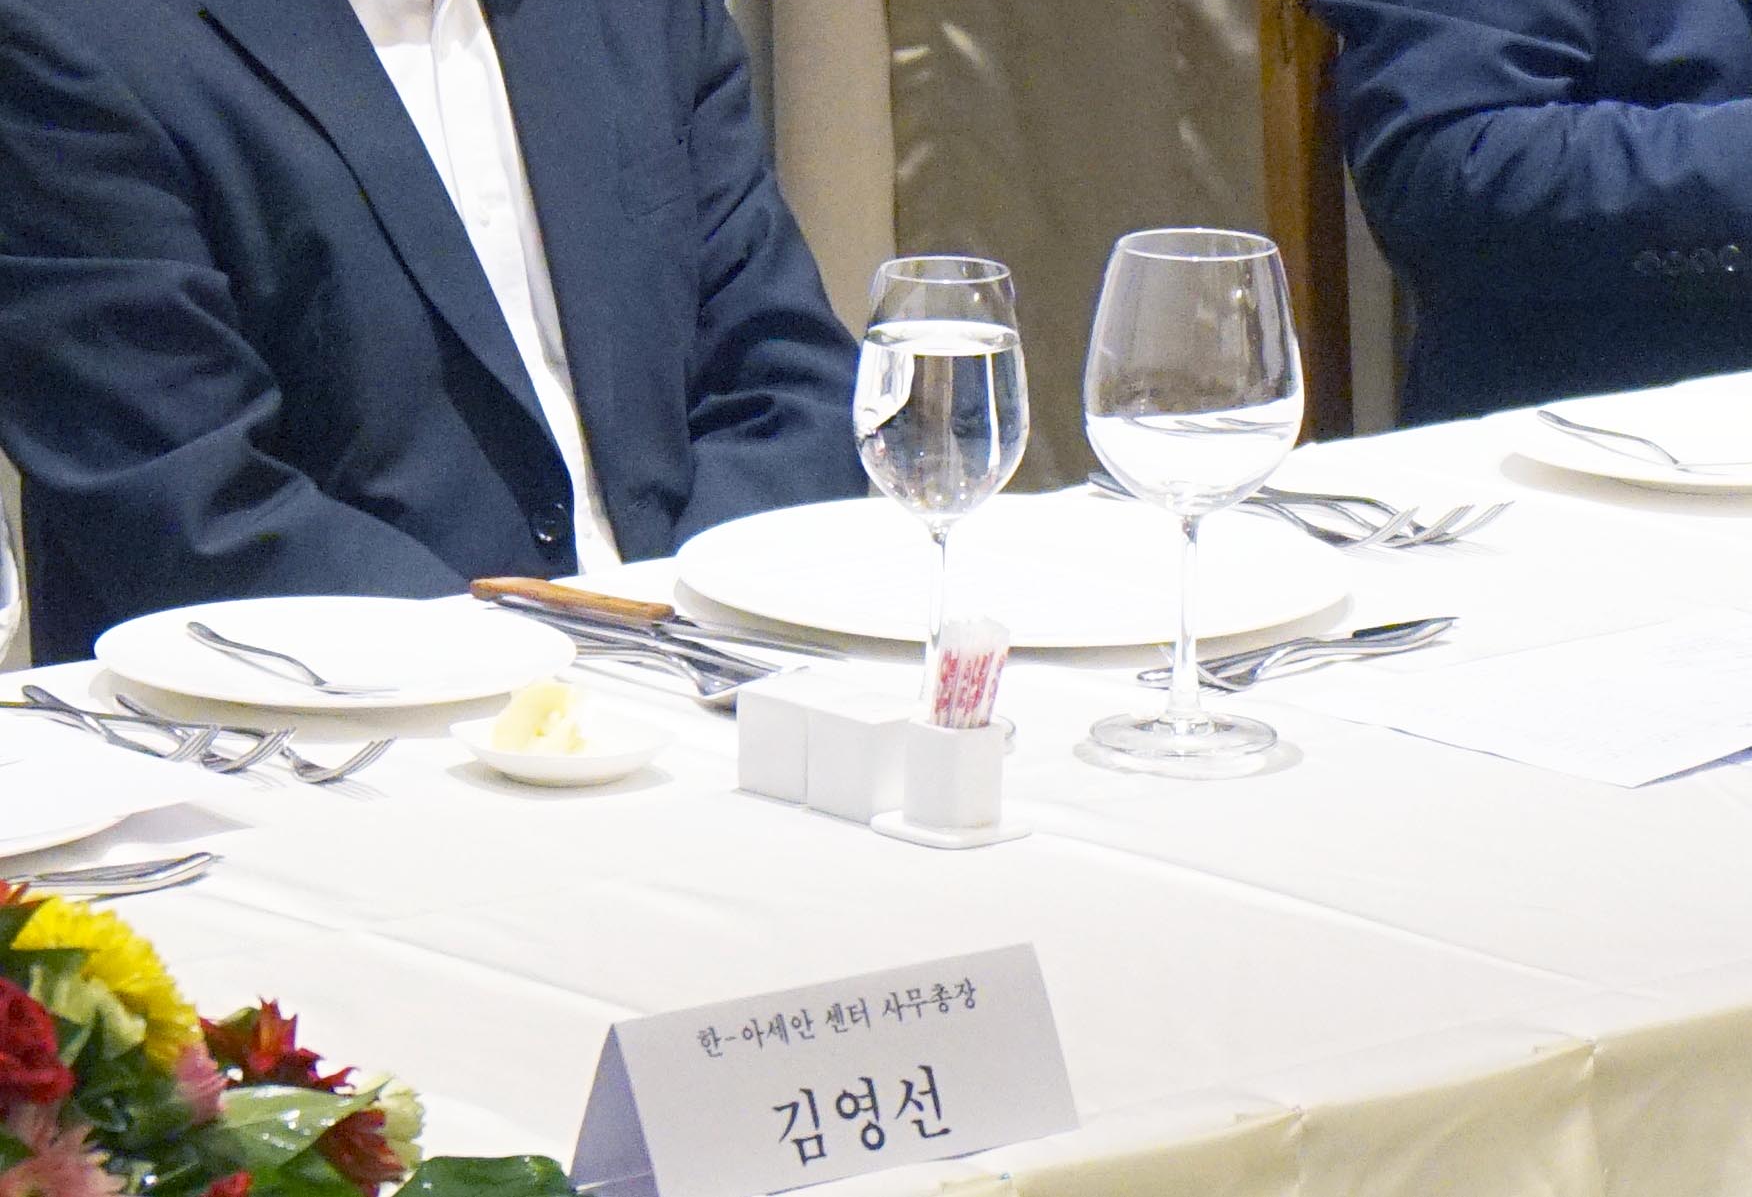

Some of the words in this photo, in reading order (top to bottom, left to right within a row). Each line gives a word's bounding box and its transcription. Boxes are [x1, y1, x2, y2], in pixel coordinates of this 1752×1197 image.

[697, 1009, 816, 1058] 한-아세안
[825, 998, 871, 1033] 센터
[882, 977, 977, 1023] 사무총장
[772, 1065, 952, 1167] 김영선
